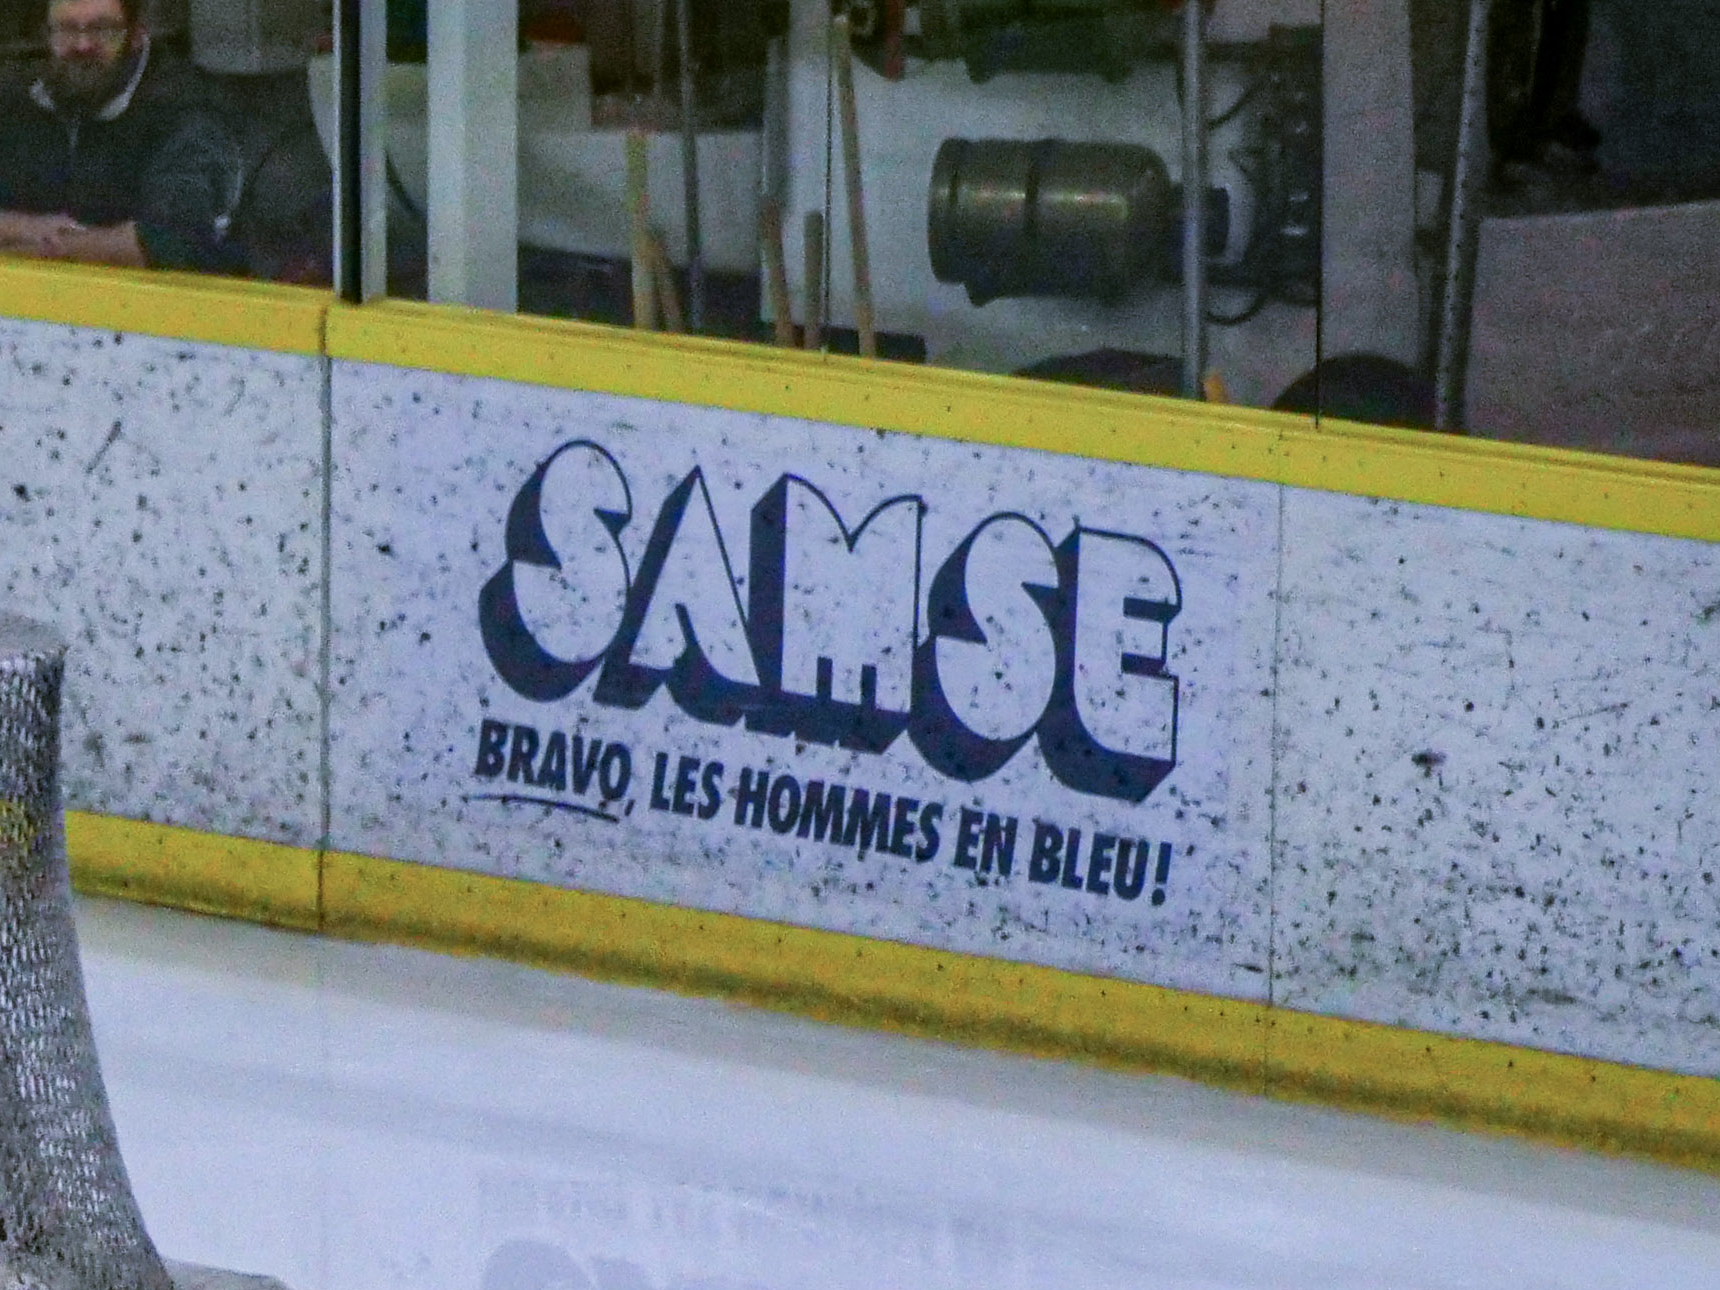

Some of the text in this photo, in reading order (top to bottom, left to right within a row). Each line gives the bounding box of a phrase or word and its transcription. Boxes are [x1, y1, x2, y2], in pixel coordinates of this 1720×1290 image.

[479, 439, 1183, 803] SAMSE
[473, 719, 1173, 906] BRAVO, LES HOMMES EN BLEU!
